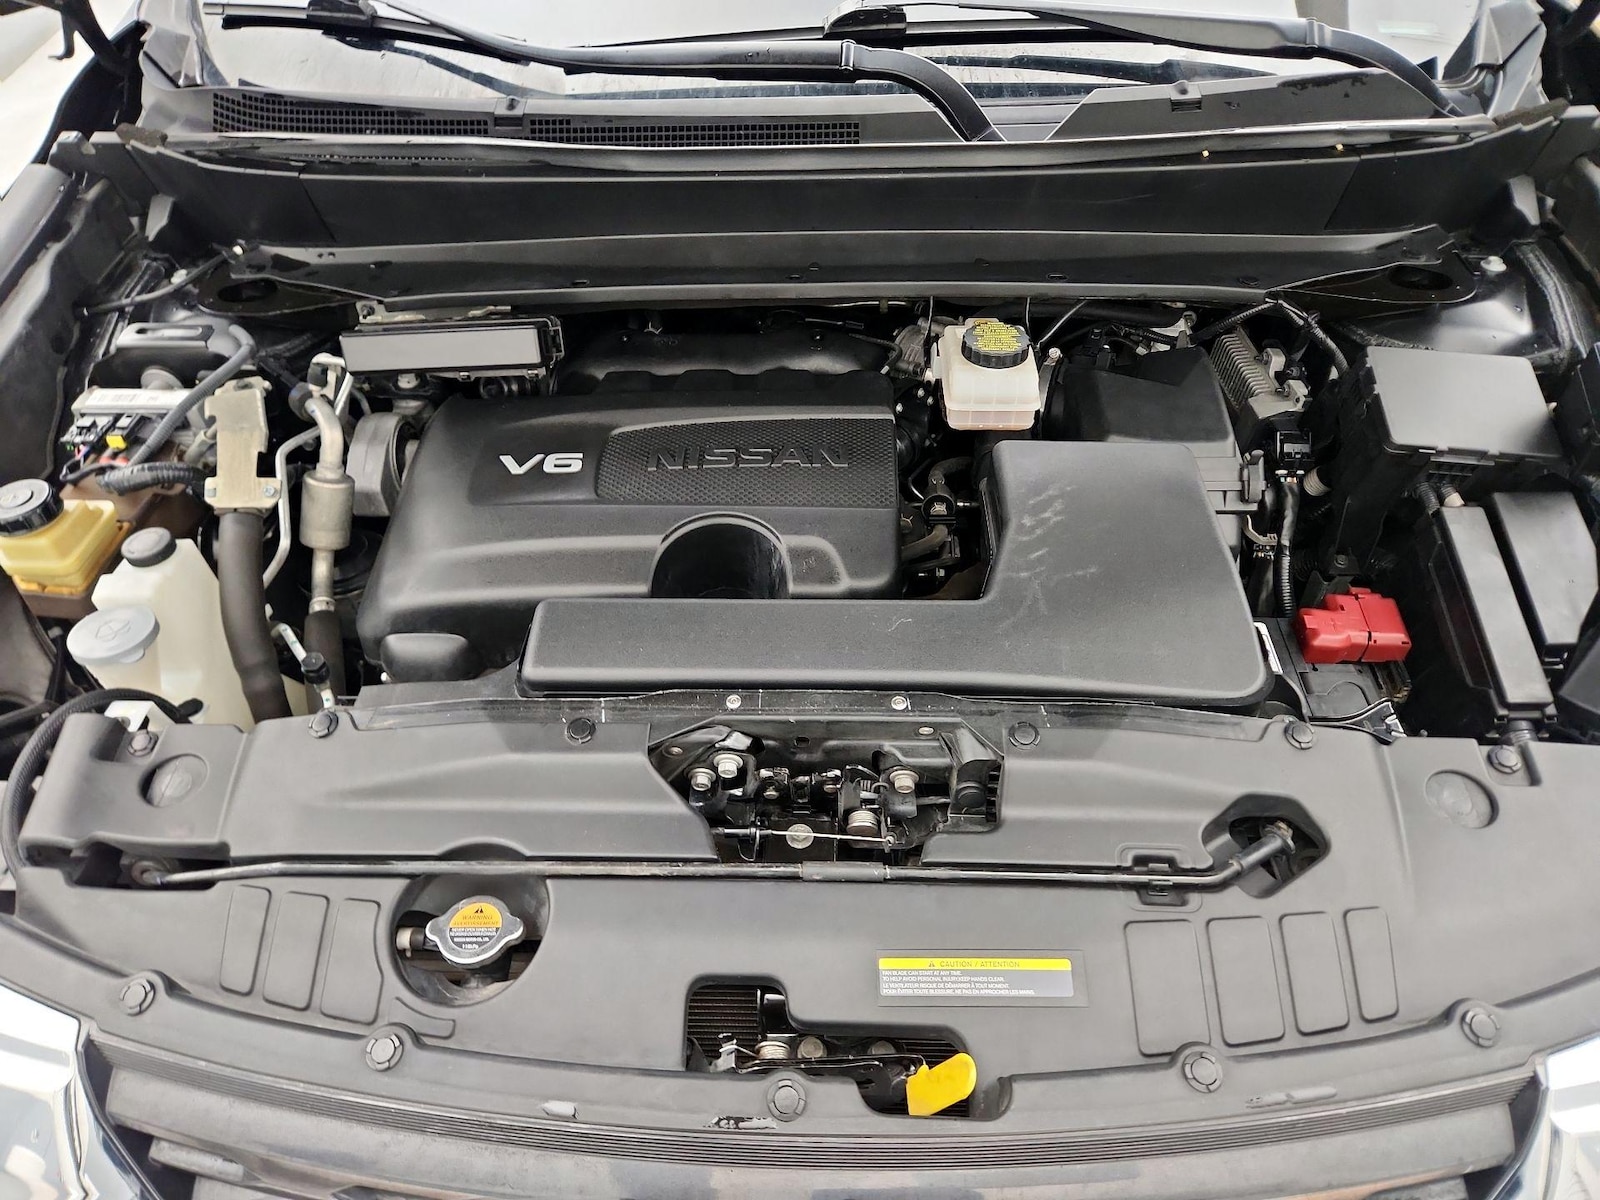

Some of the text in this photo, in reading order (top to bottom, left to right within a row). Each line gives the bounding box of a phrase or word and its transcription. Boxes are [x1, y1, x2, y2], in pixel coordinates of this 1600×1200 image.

[498, 452, 584, 475] V6
[646, 443, 850, 471] NISSAN
[940, 960, 972, 968] CAUTION
[981, 960, 1019, 968] ATTENTION
